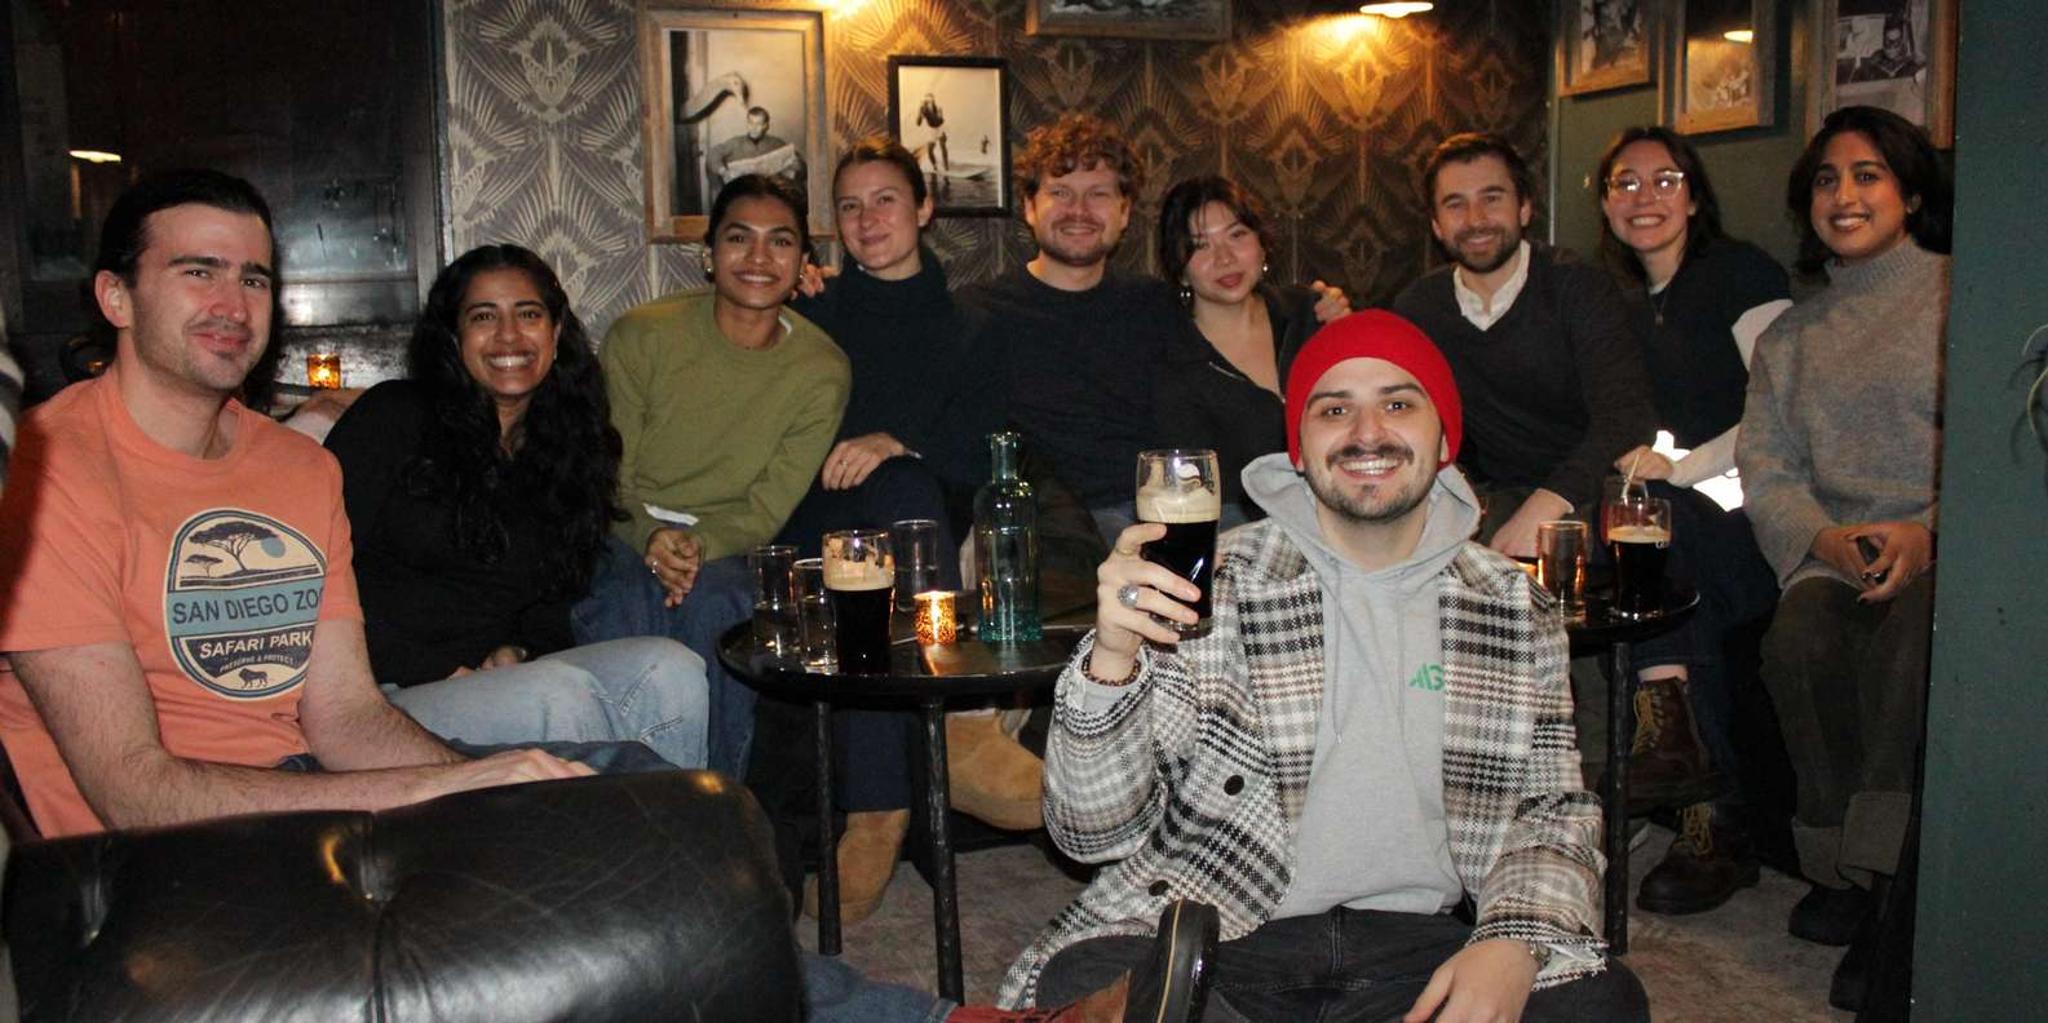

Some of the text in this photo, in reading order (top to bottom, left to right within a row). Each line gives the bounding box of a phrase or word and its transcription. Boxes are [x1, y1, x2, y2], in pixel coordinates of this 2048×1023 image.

[173, 588, 324, 624] SAN DIEGO ZO
[200, 630, 312, 659] SAFARI PARK
